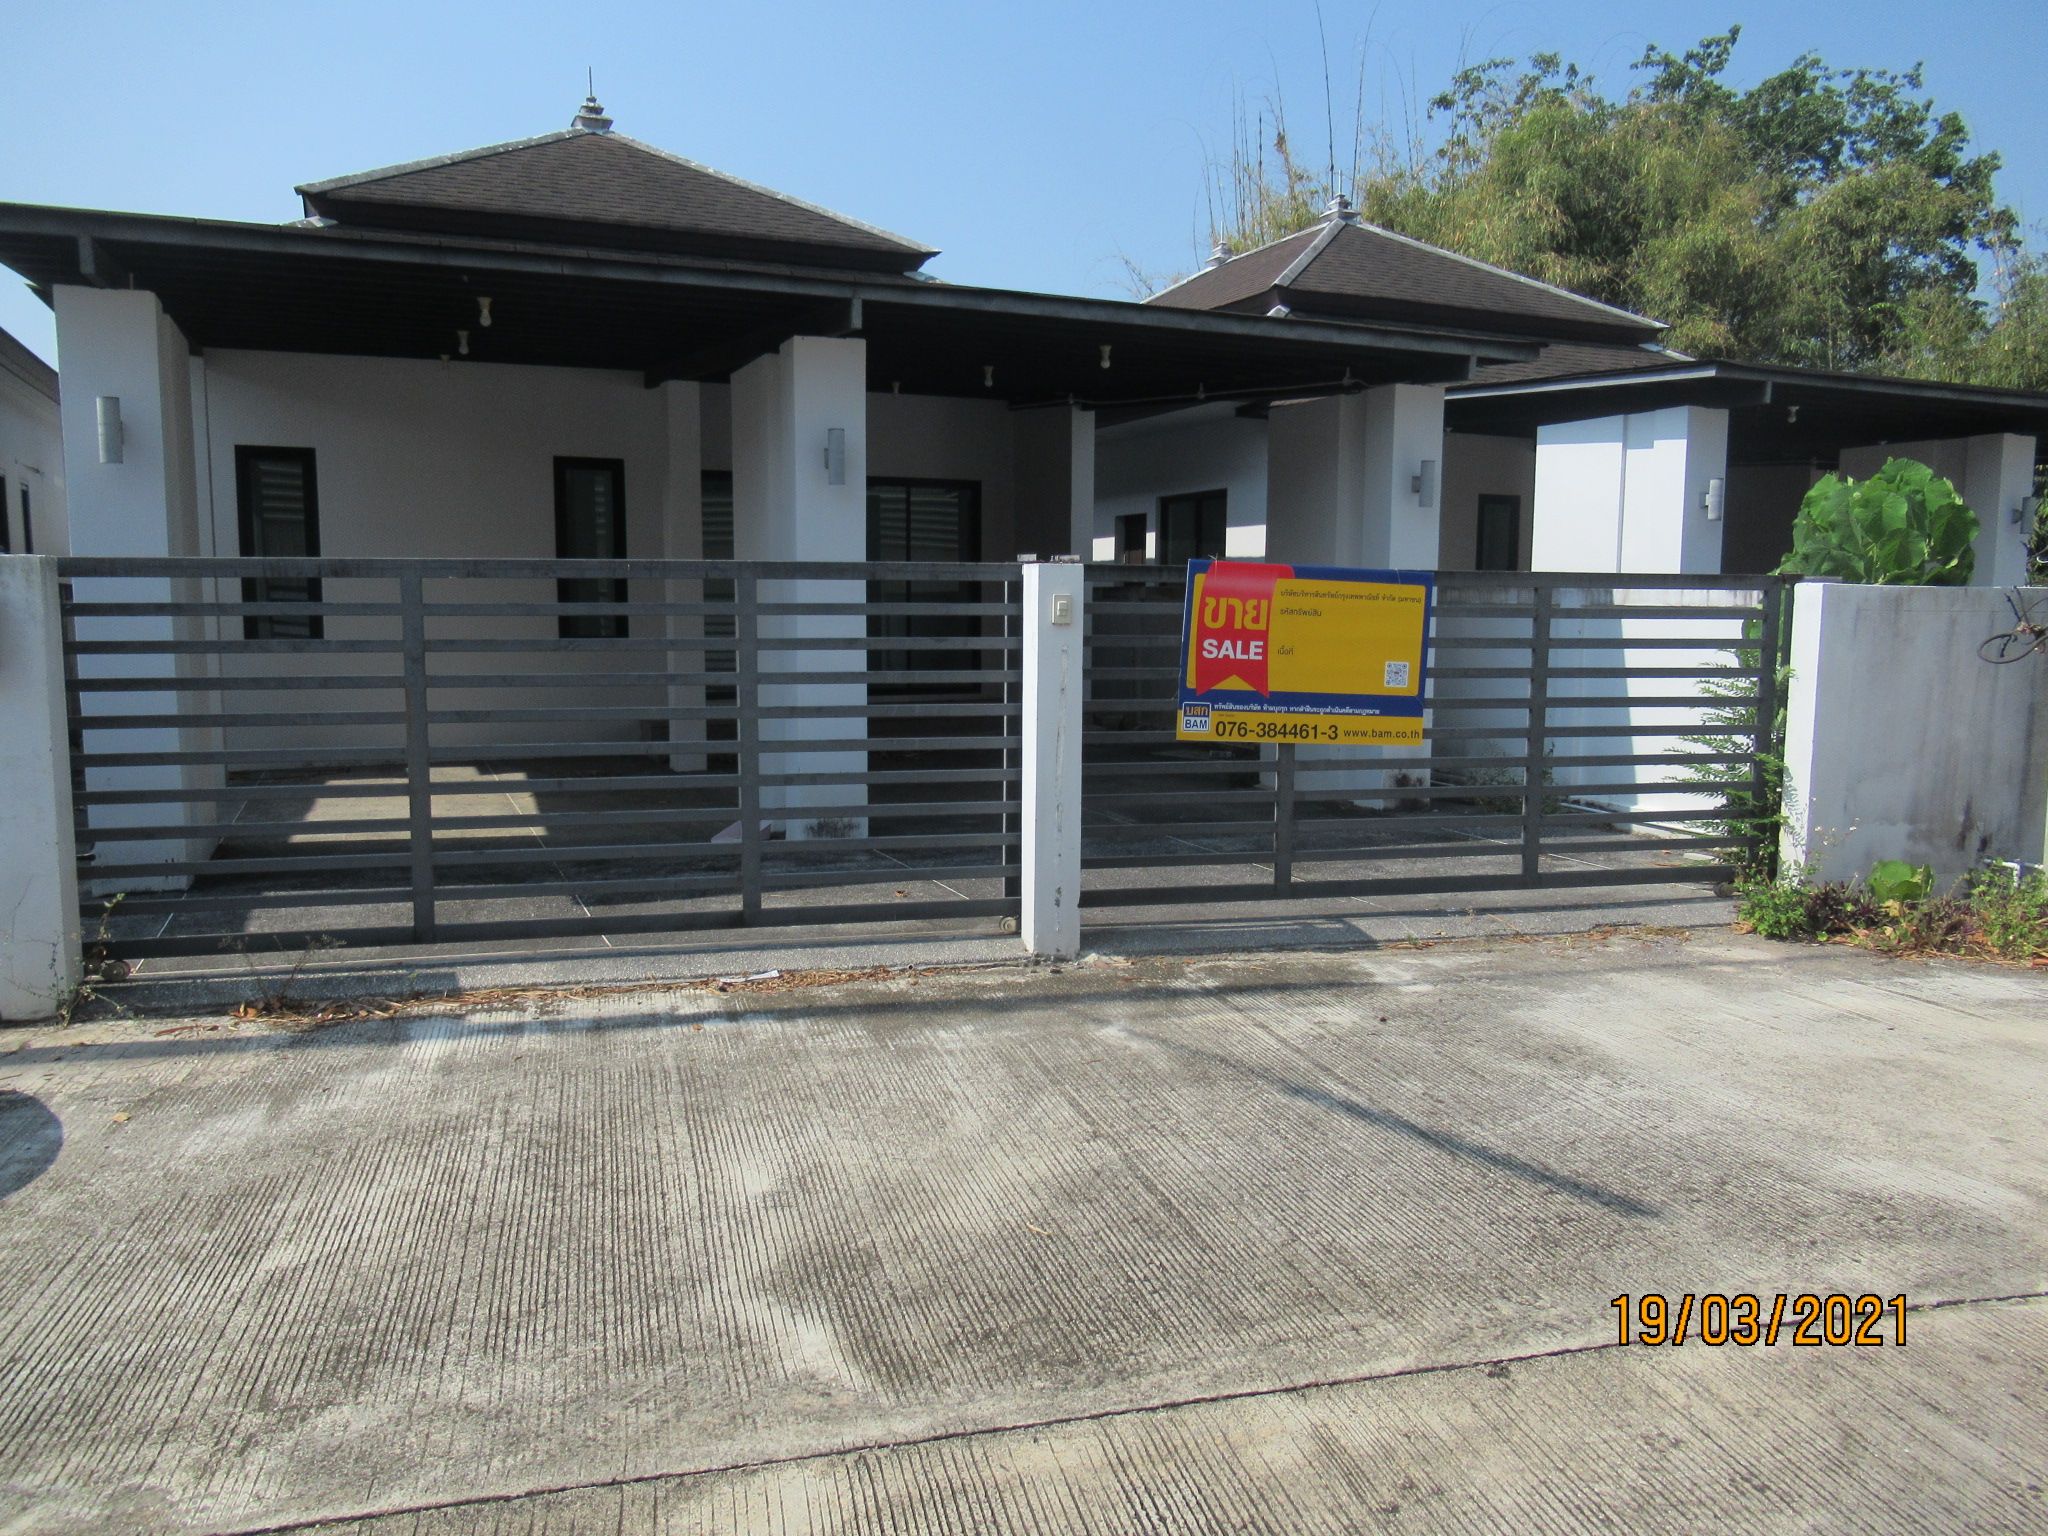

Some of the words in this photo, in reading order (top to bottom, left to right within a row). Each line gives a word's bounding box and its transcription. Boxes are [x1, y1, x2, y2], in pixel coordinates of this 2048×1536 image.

[1203, 596, 1268, 631] ขาย
[1202, 638, 1264, 660] SALE
[1185, 705, 1209, 716] บสก
[1184, 719, 1208, 729] BAM
[1215, 721, 1339, 740] 076-384461-3
[1343, 729, 1420, 739] www.bam.co.th
